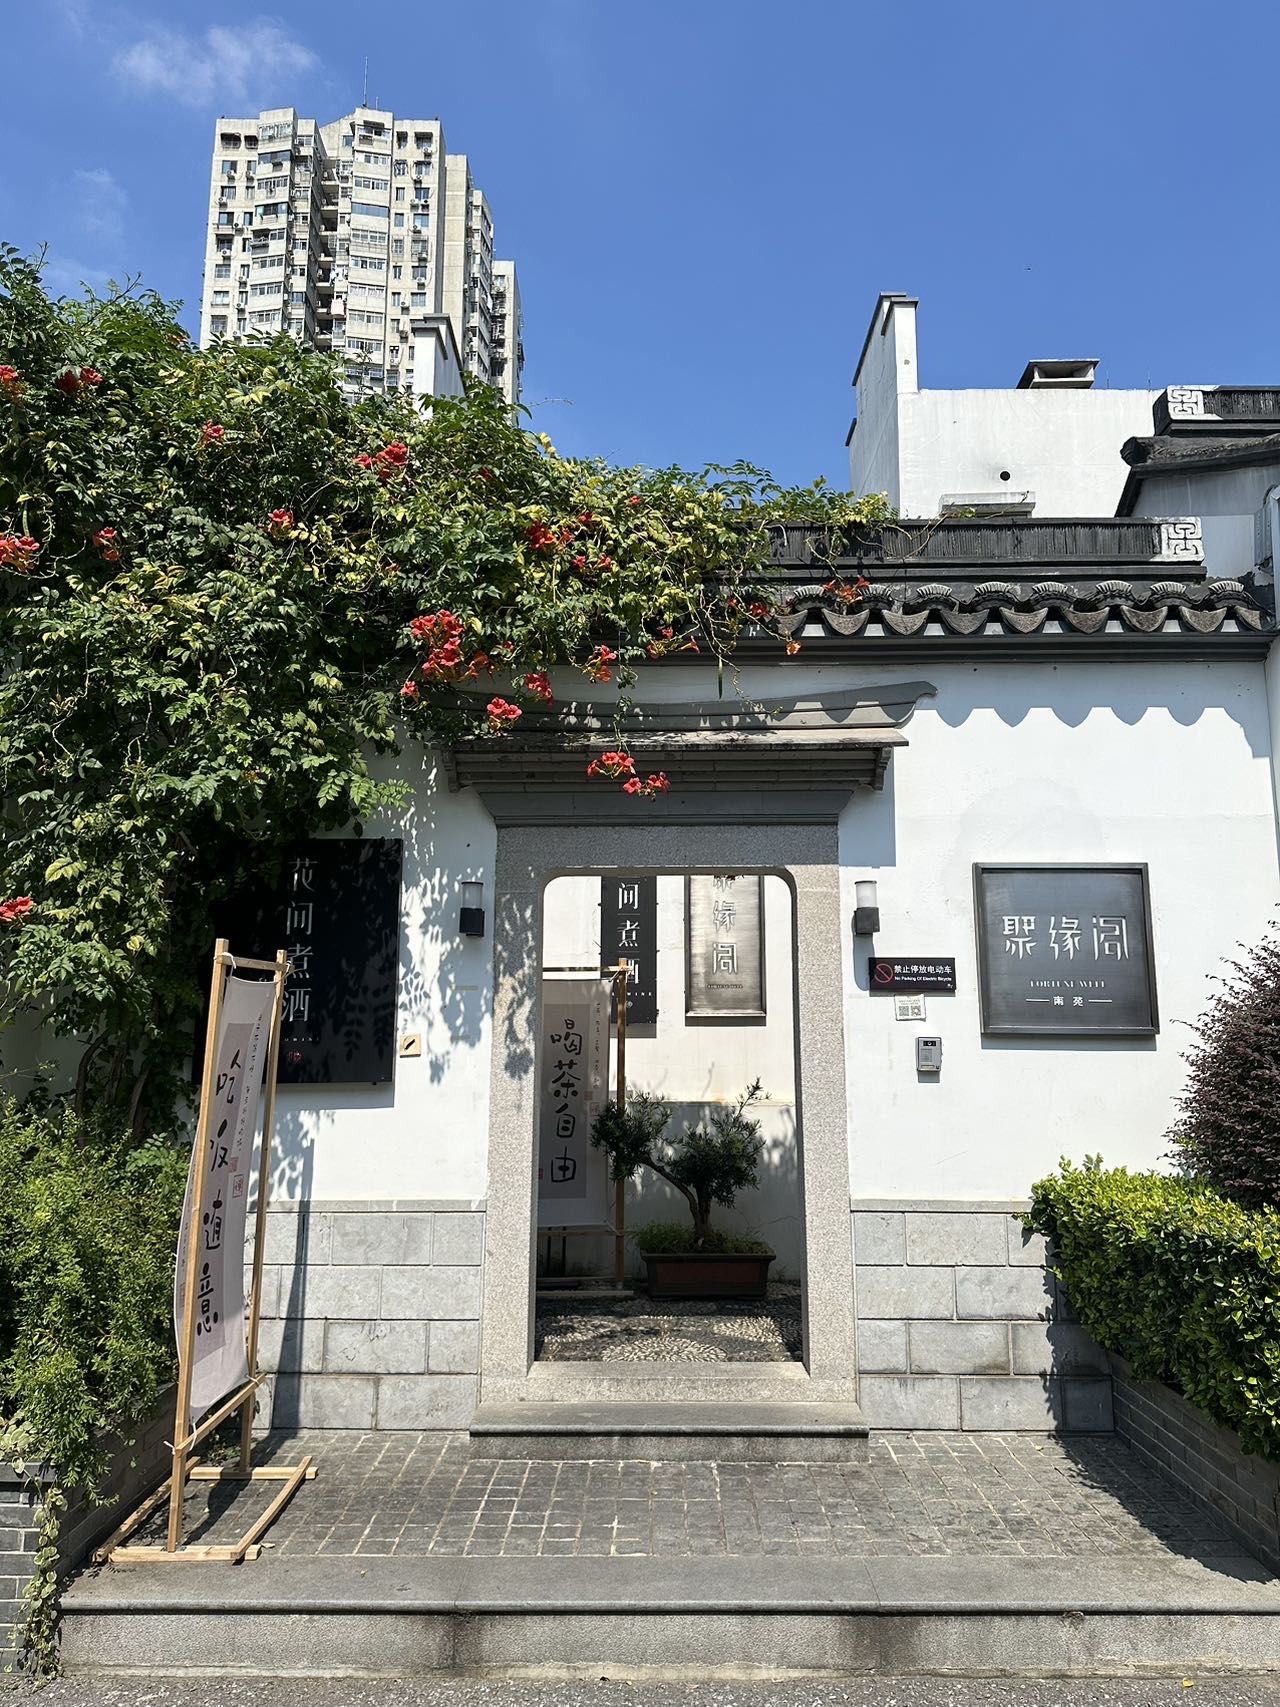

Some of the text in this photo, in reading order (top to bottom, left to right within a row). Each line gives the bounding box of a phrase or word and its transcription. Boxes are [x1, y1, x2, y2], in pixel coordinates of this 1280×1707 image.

[281, 857, 318, 1023] 花间煮酒
[1002, 915, 1130, 961] 聚缘阁
[894, 965, 953, 974] 禁止停放电动车
[1053, 995, 1084, 1007] 南苑
[550, 1018, 582, 1183] 喝茶自由
